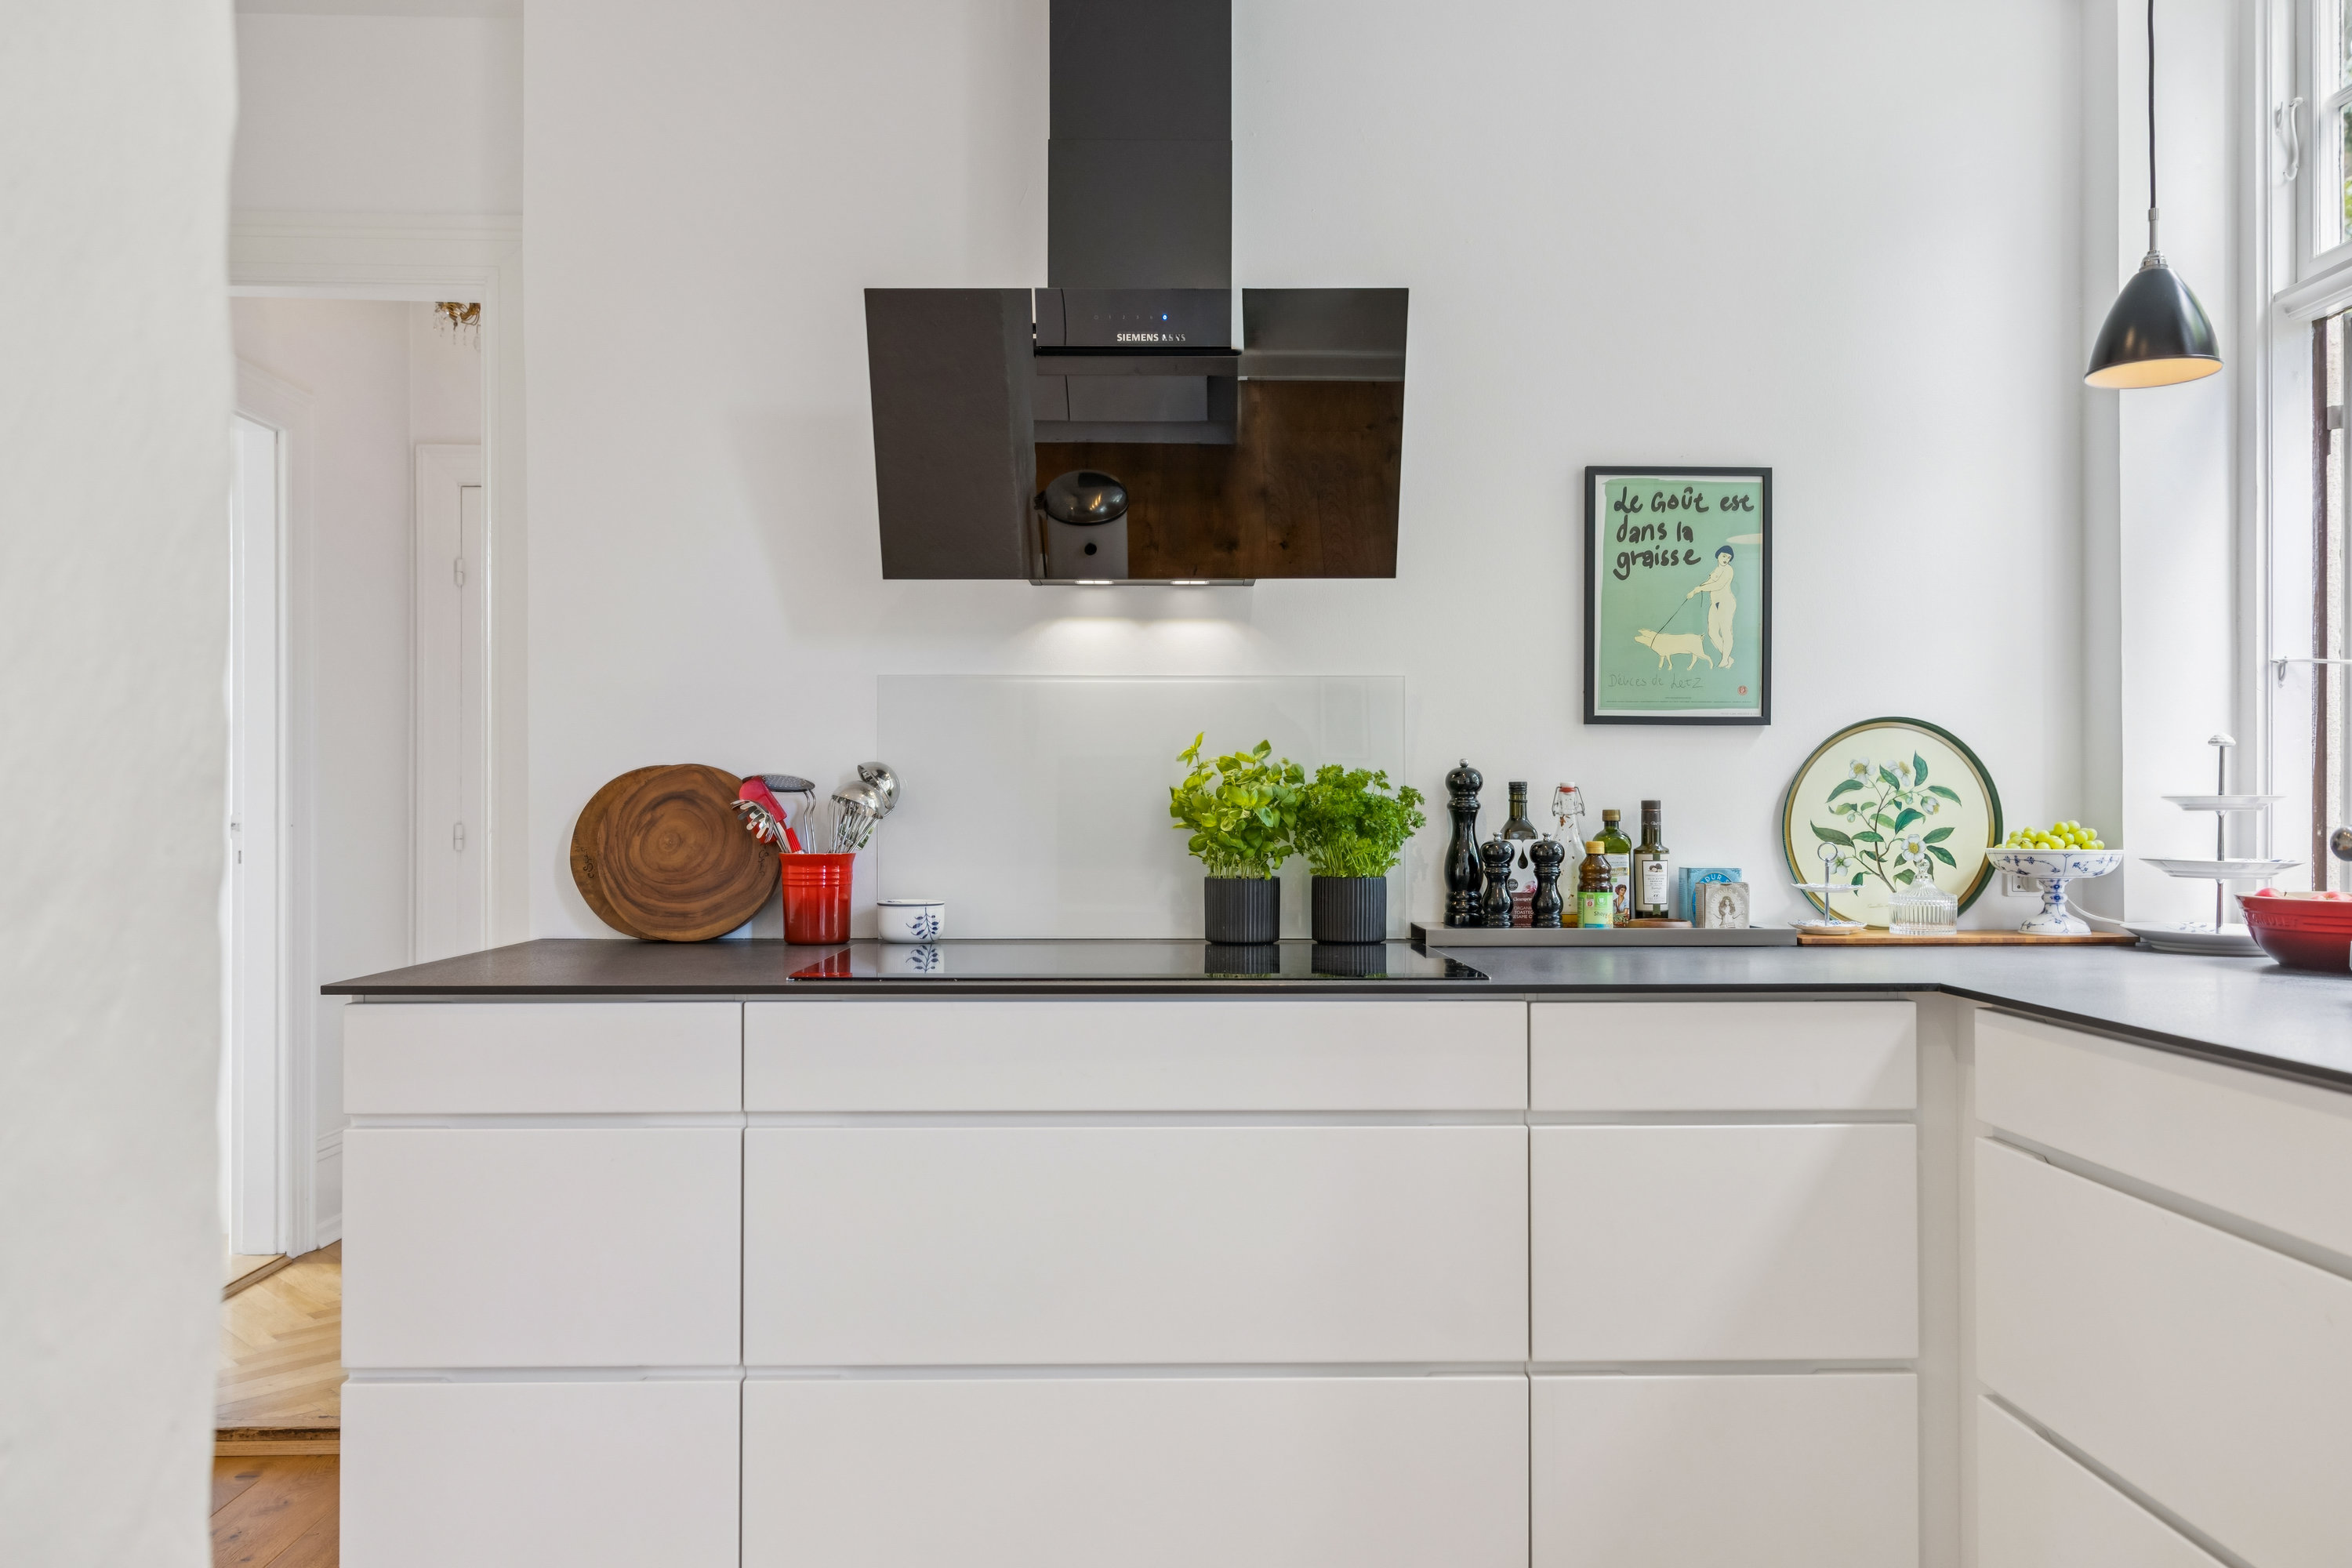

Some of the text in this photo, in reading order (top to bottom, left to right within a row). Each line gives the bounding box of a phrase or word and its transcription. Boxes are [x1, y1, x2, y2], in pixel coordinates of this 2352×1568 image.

[1116, 333, 1159, 342] SIEMENS
[1613, 486, 1754, 514] Le Goût est
[1617, 514, 1694, 543] dans la
[1613, 545, 1701, 581] graisse
